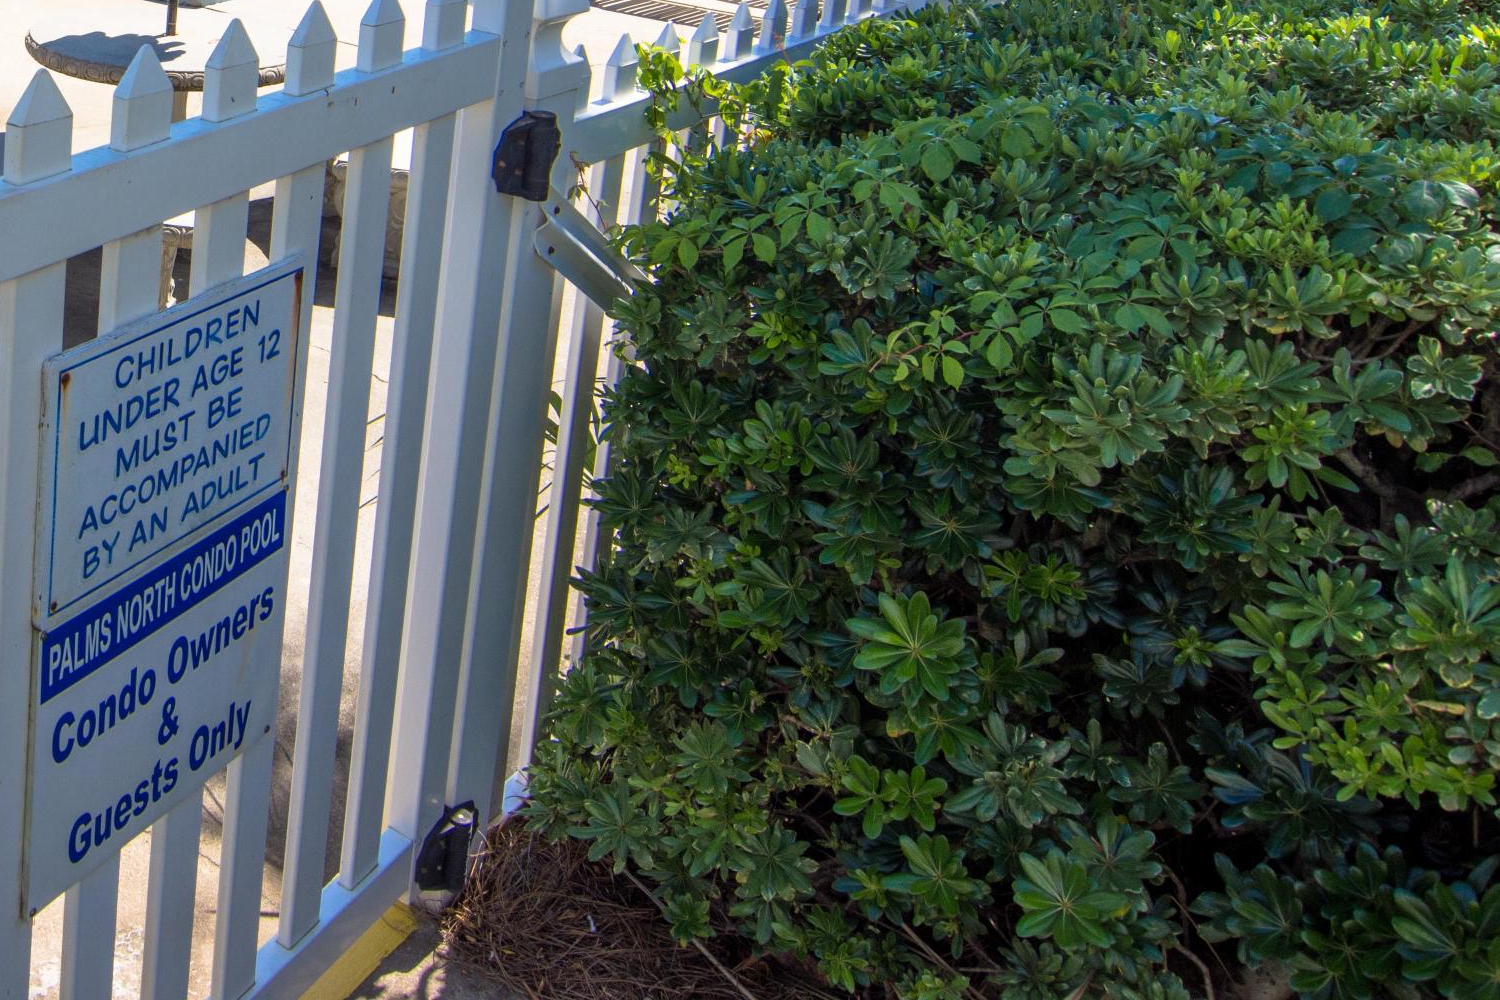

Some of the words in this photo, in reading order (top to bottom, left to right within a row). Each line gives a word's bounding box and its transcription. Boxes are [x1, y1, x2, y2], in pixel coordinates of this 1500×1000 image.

[79, 377, 180, 451] UNDER
[191, 346, 243, 398] AGE
[258, 329, 281, 363] 12
[115, 300, 260, 388] CHILDREN
[78, 413, 271, 540] ACCOMPANIED
[116, 411, 195, 478] MUST
[208, 387, 243, 428] BE
[82, 532, 120, 580] BY
[128, 506, 168, 553] AN
[181, 453, 265, 522] ADULT
[48, 615, 112, 687] PALMS
[116, 572, 176, 639] NORTH
[180, 534, 237, 601] CONDO
[240, 508, 280, 565] POOL
[52, 667, 156, 763] Condo
[167, 586, 274, 684] Owners
[157, 696, 179, 746] &
[68, 758, 179, 864] Guests
[188, 700, 252, 772] Only
